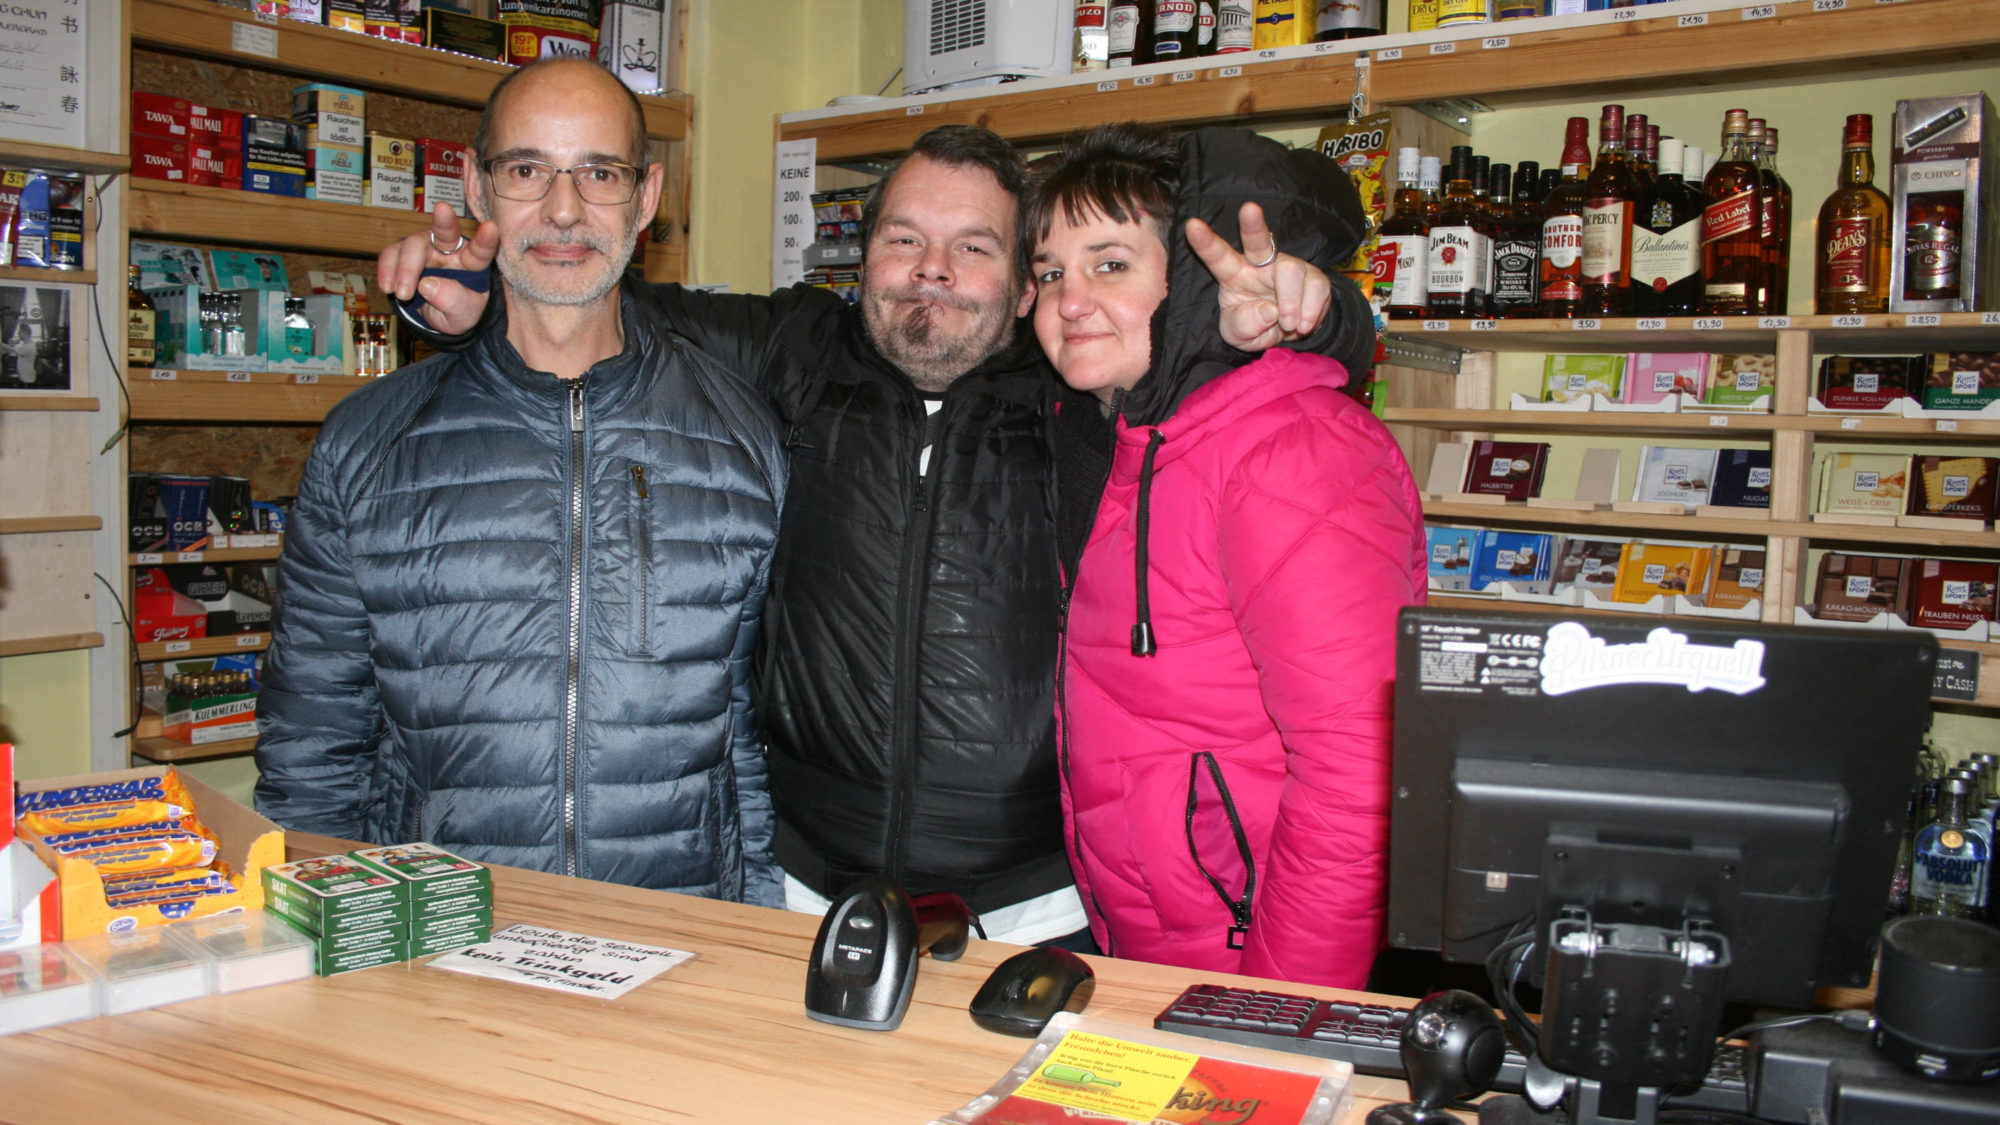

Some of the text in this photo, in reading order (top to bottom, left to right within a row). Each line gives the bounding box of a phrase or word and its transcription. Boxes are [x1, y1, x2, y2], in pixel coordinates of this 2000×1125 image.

[144, 110, 176, 125] TAWA
[326, 114, 361, 127] Rauchen
[338, 126, 349, 134] ist
[330, 133, 357, 145] tödlich
[1323, 129, 1384, 157] HARIBO
[144, 153, 174, 168] TAWA
[192, 157, 224, 174] PALL MALL
[377, 172, 413, 187] Rauchen
[780, 167, 810, 180] KEINE
[1924, 170, 1961, 181] CHIVAS
[390, 184, 401, 194] ist
[381, 193, 409, 206] tödlich
[784, 191, 799, 203] 200
[783, 214, 799, 225] 100
[1706, 203, 1751, 227] Red Label
[784, 237, 795, 248] 50
[1430, 233, 1469, 251] JIM BEAM
[1931, 241, 1961, 255] REGAL
[1494, 245, 1510, 260] JACK
[1924, 255, 1934, 264] 12
[1432, 274, 1464, 284] BOURBON
[1655, 381, 1673, 389] SPORT
[1738, 381, 1757, 389] SPORT
[1935, 397, 1961, 405] GANZE
[1750, 477, 1769, 485] SPORT
[132, 525, 164, 538] OCB
[173, 521, 203, 532] OCB
[1924, 610, 1985, 621] TRAUBEN NUSS
[1946, 675, 1974, 692] CASH
[194, 699, 255, 722] KUEMMERLING
[1920, 856, 1984, 873] ABSOLUT
[1926, 869, 1973, 885] VODKA
[271, 878, 288, 897] SKAT
[274, 896, 290, 914] SKAT
[460, 948, 635, 985] kein Trinkgeld
[1070, 1033, 1154, 1056] Halte die Umwelt
